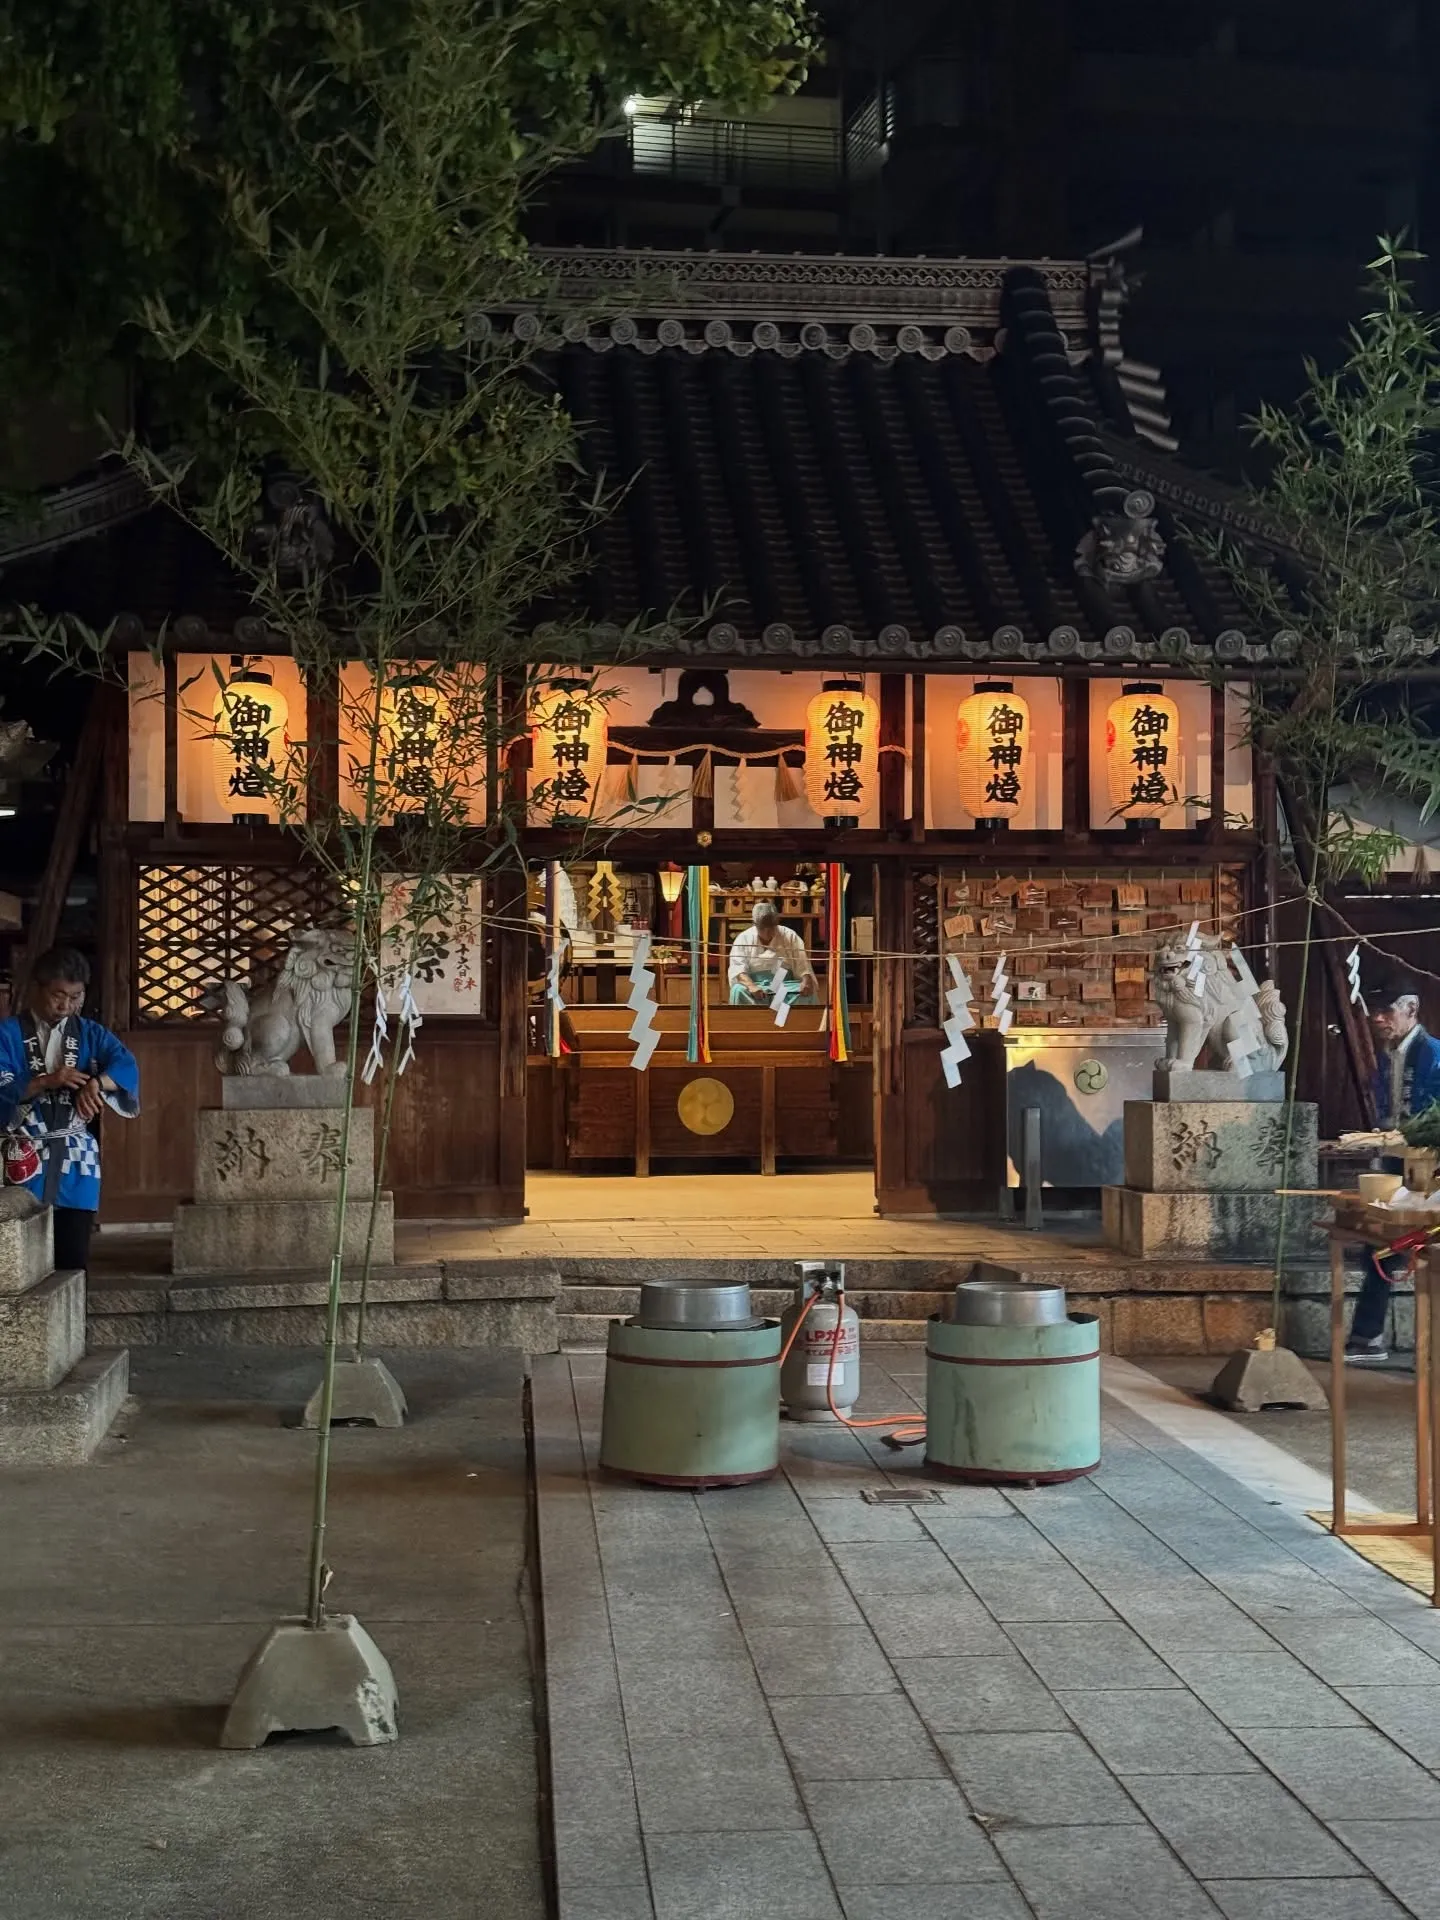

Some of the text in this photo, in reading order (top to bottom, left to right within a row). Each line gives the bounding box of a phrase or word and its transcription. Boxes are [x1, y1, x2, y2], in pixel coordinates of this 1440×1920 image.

[824, 700, 865, 803] 御神燈
[984, 703, 1024, 806] 御神燈
[1128, 704, 1169, 806] 御神燈
